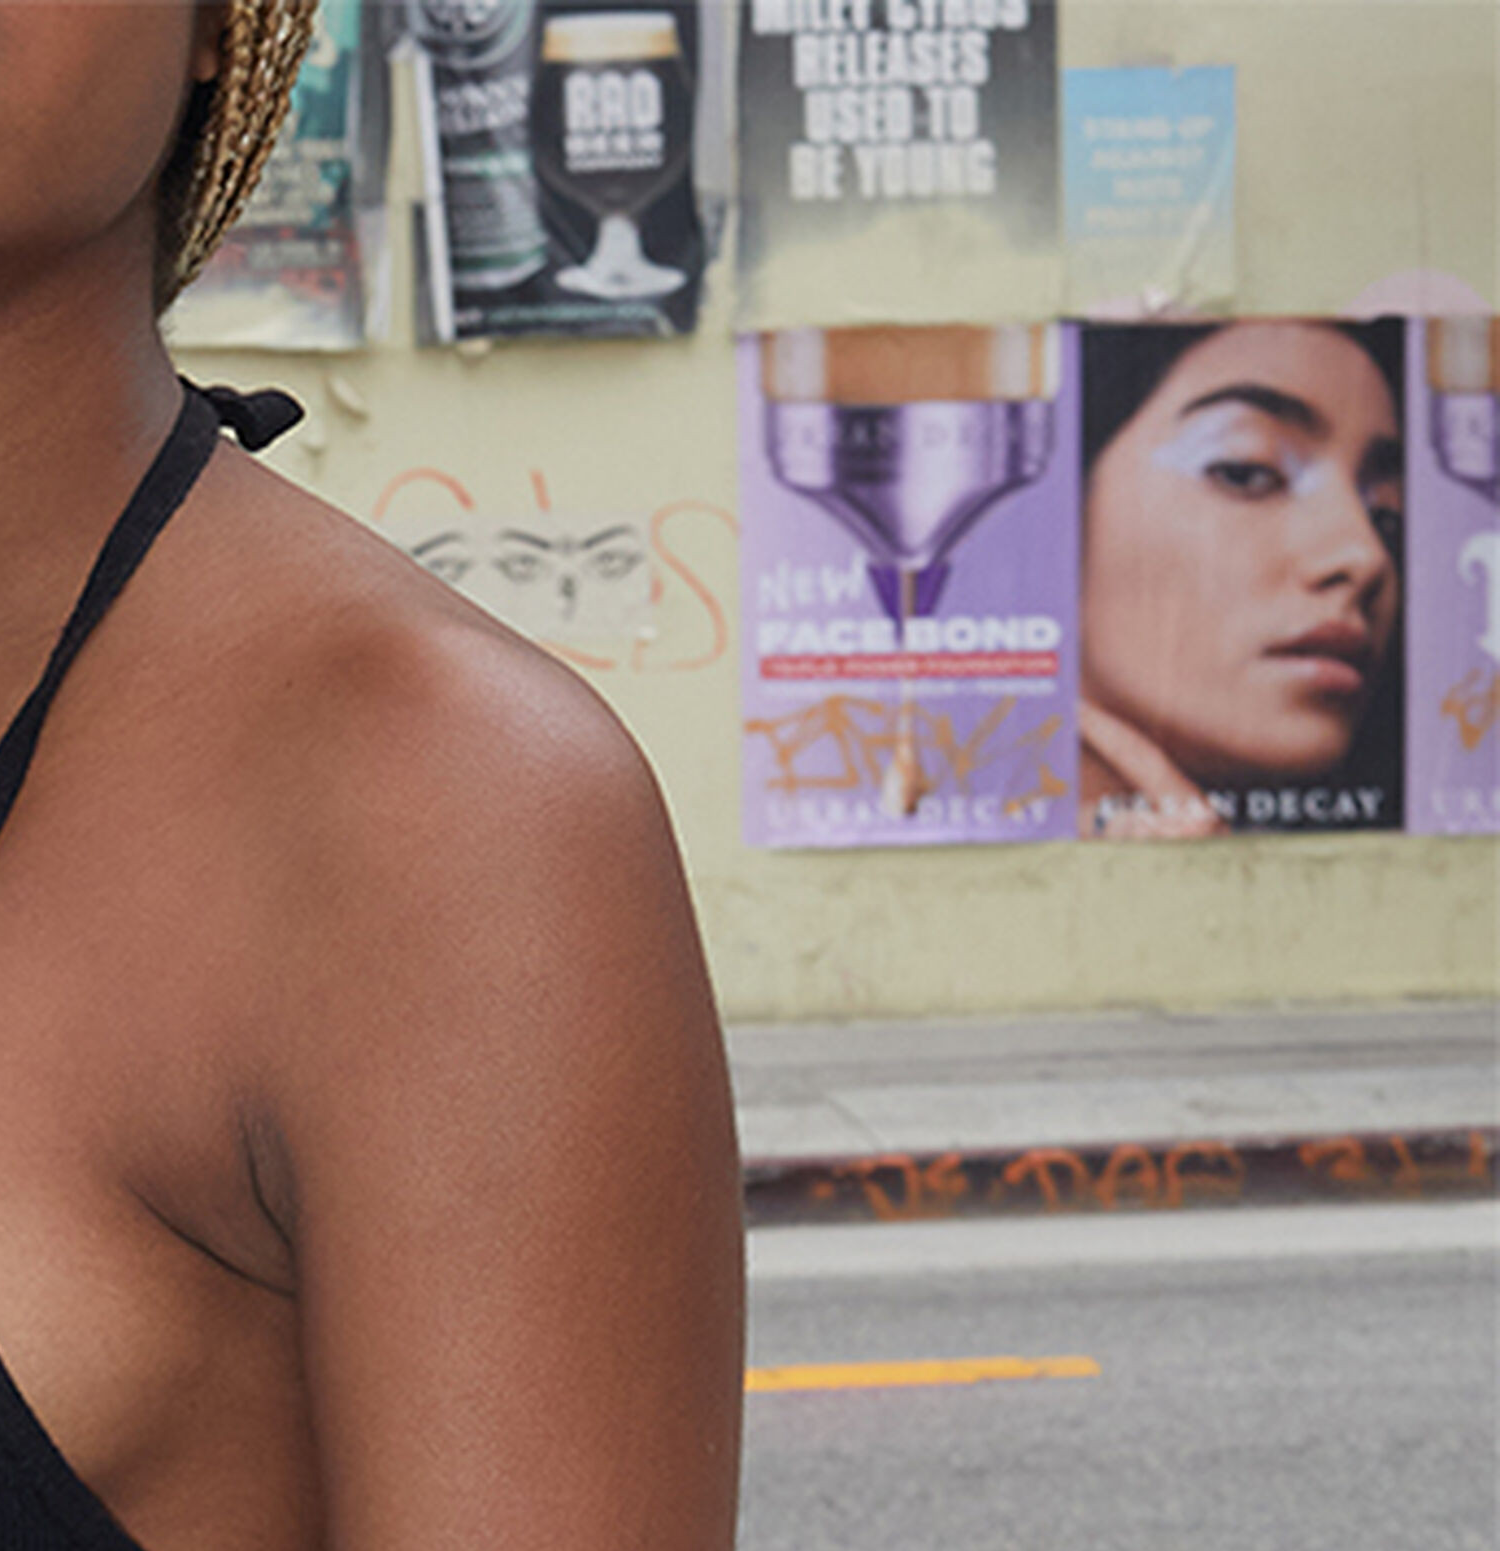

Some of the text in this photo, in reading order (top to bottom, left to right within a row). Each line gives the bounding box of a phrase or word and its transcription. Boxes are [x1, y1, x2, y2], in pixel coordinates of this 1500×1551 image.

[794, 30, 990, 88] RELEASES
[805, 86, 978, 143] USED TO
[790, 139, 996, 199] BE YOUNG
[1246, 786, 1385, 821] DECAY
